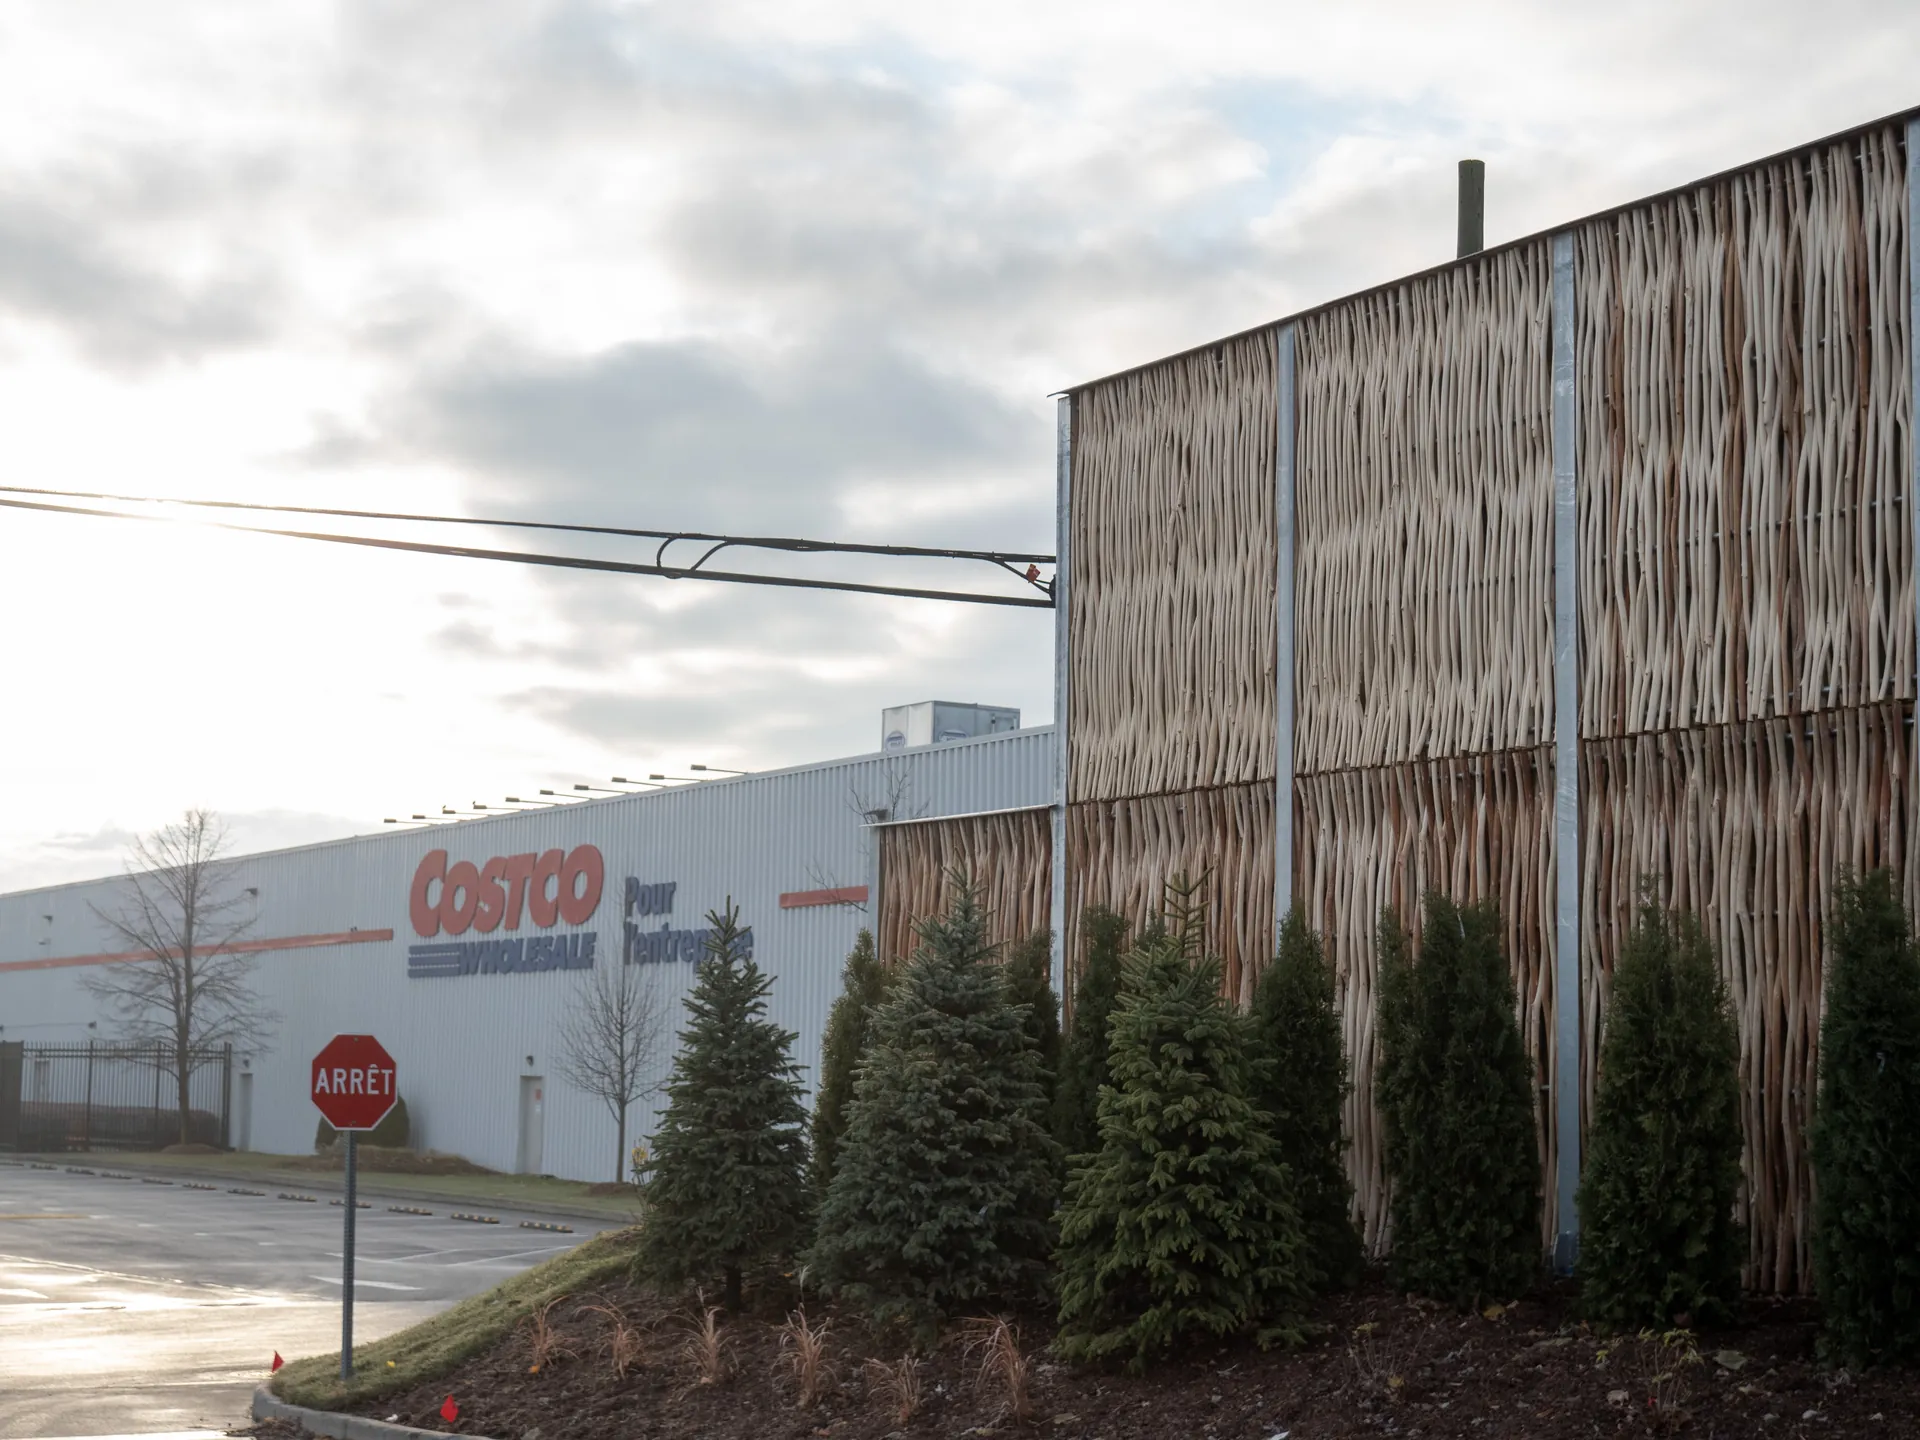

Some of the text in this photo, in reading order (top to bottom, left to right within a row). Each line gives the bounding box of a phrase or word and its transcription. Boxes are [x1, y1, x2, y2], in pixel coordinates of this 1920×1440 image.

[408, 844, 605, 937] COSTCO
[624, 876, 677, 917] Pour
[459, 932, 597, 976] WHOLESALE
[315, 1064, 393, 1095] ARRÊT
